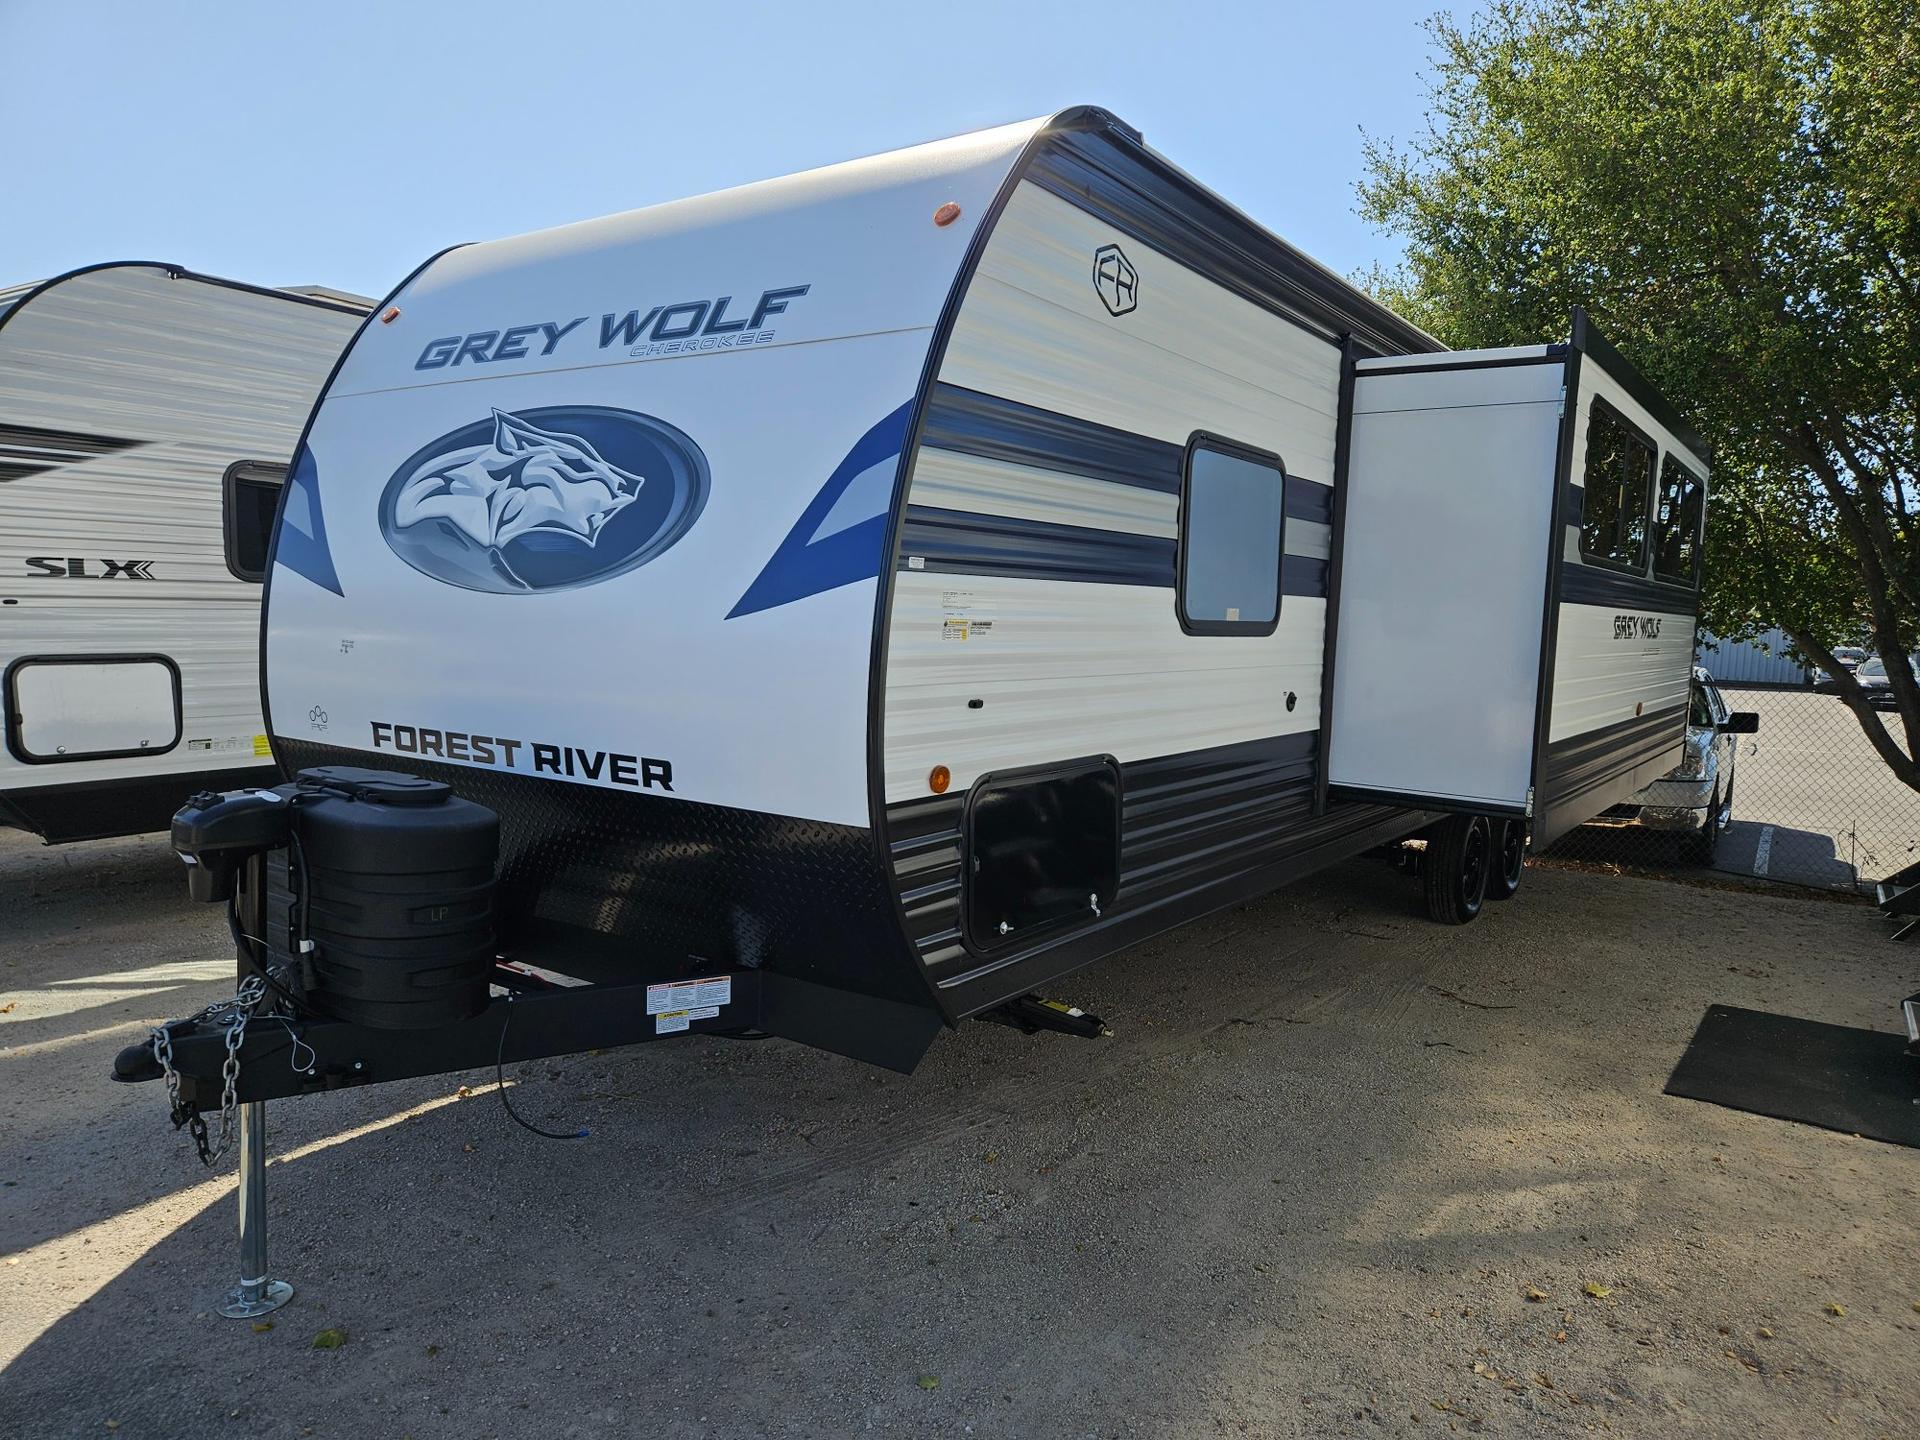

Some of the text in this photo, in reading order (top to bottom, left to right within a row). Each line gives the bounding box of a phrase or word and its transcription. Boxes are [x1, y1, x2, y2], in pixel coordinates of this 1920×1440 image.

[414, 284, 811, 370] GREY WOLF
[630, 330, 775, 356] CHEROKEE
[25, 557, 156, 580] SLX
[1614, 615, 1661, 639] GREY WOLF
[370, 721, 675, 792] FOREST RIVER
[432, 906, 448, 920] LP
